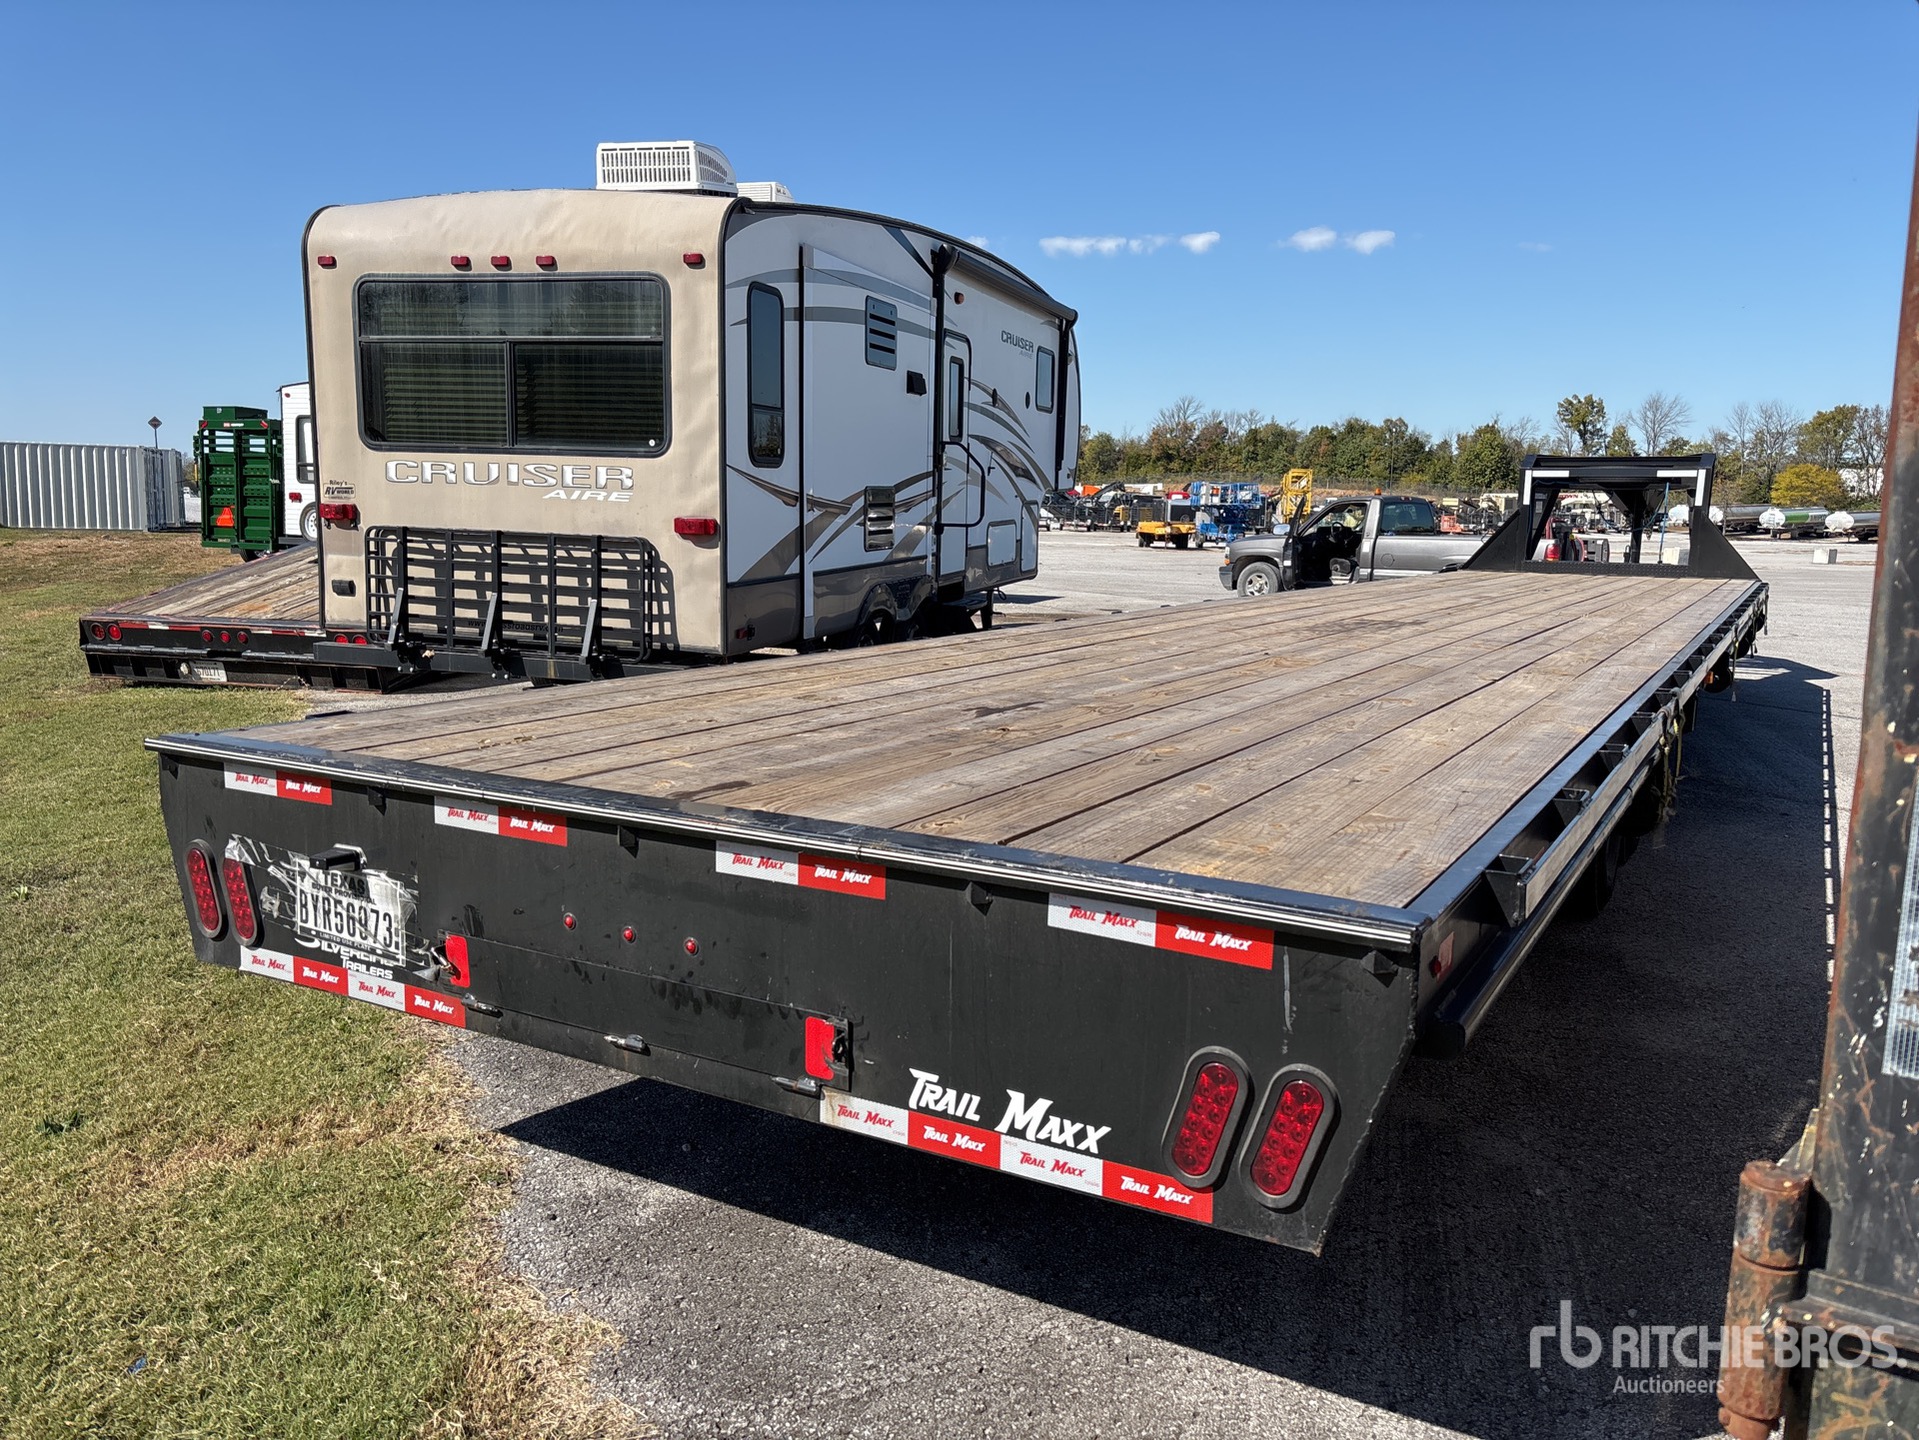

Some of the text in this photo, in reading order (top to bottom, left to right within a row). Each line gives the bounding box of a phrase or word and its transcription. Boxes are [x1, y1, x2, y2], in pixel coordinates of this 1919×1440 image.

[1001, 330, 1034, 353] CRUISER
[385, 459, 635, 490] CRUISER
[325, 486, 337, 495] RV
[542, 489, 634, 503] AIRE
[236, 772, 269, 785] TRAIL MAXX
[286, 780, 322, 794] TRAIL MAXX
[448, 807, 488, 821] TRAIL MAXX
[510, 816, 528, 828] TRAIL
[530, 820, 554, 832] MAXX
[732, 853, 785, 870] TRAIL MAXX
[322, 870, 366, 895] TEXAS
[815, 864, 872, 884] TRAIL MAXX
[1069, 905, 1138, 928] TRAIL MAXX
[320, 932, 340, 942] LIMITED
[354, 941, 371, 951] PLATE
[1175, 924, 1252, 950] TRAIL MAXX
[252, 955, 286, 970] TRAIL MAXX
[340, 955, 393, 979] TRAILERS
[303, 966, 339, 984] TRAIL MAXX
[359, 981, 396, 998] TRAIL MAXX
[414, 995, 454, 1014] TRAIL MAXX
[838, 1104, 894, 1128] TRAIL MAXX
[908, 1067, 1112, 1154] TRAIL MAXX
[923, 1125, 948, 1144] TRAIL
[952, 1132, 986, 1152] MAXX
[1020, 1151, 1086, 1177] TRAIL MAXX
[1121, 1176, 1150, 1194] TRAIL
[1153, 1184, 1193, 1204] MAXX
